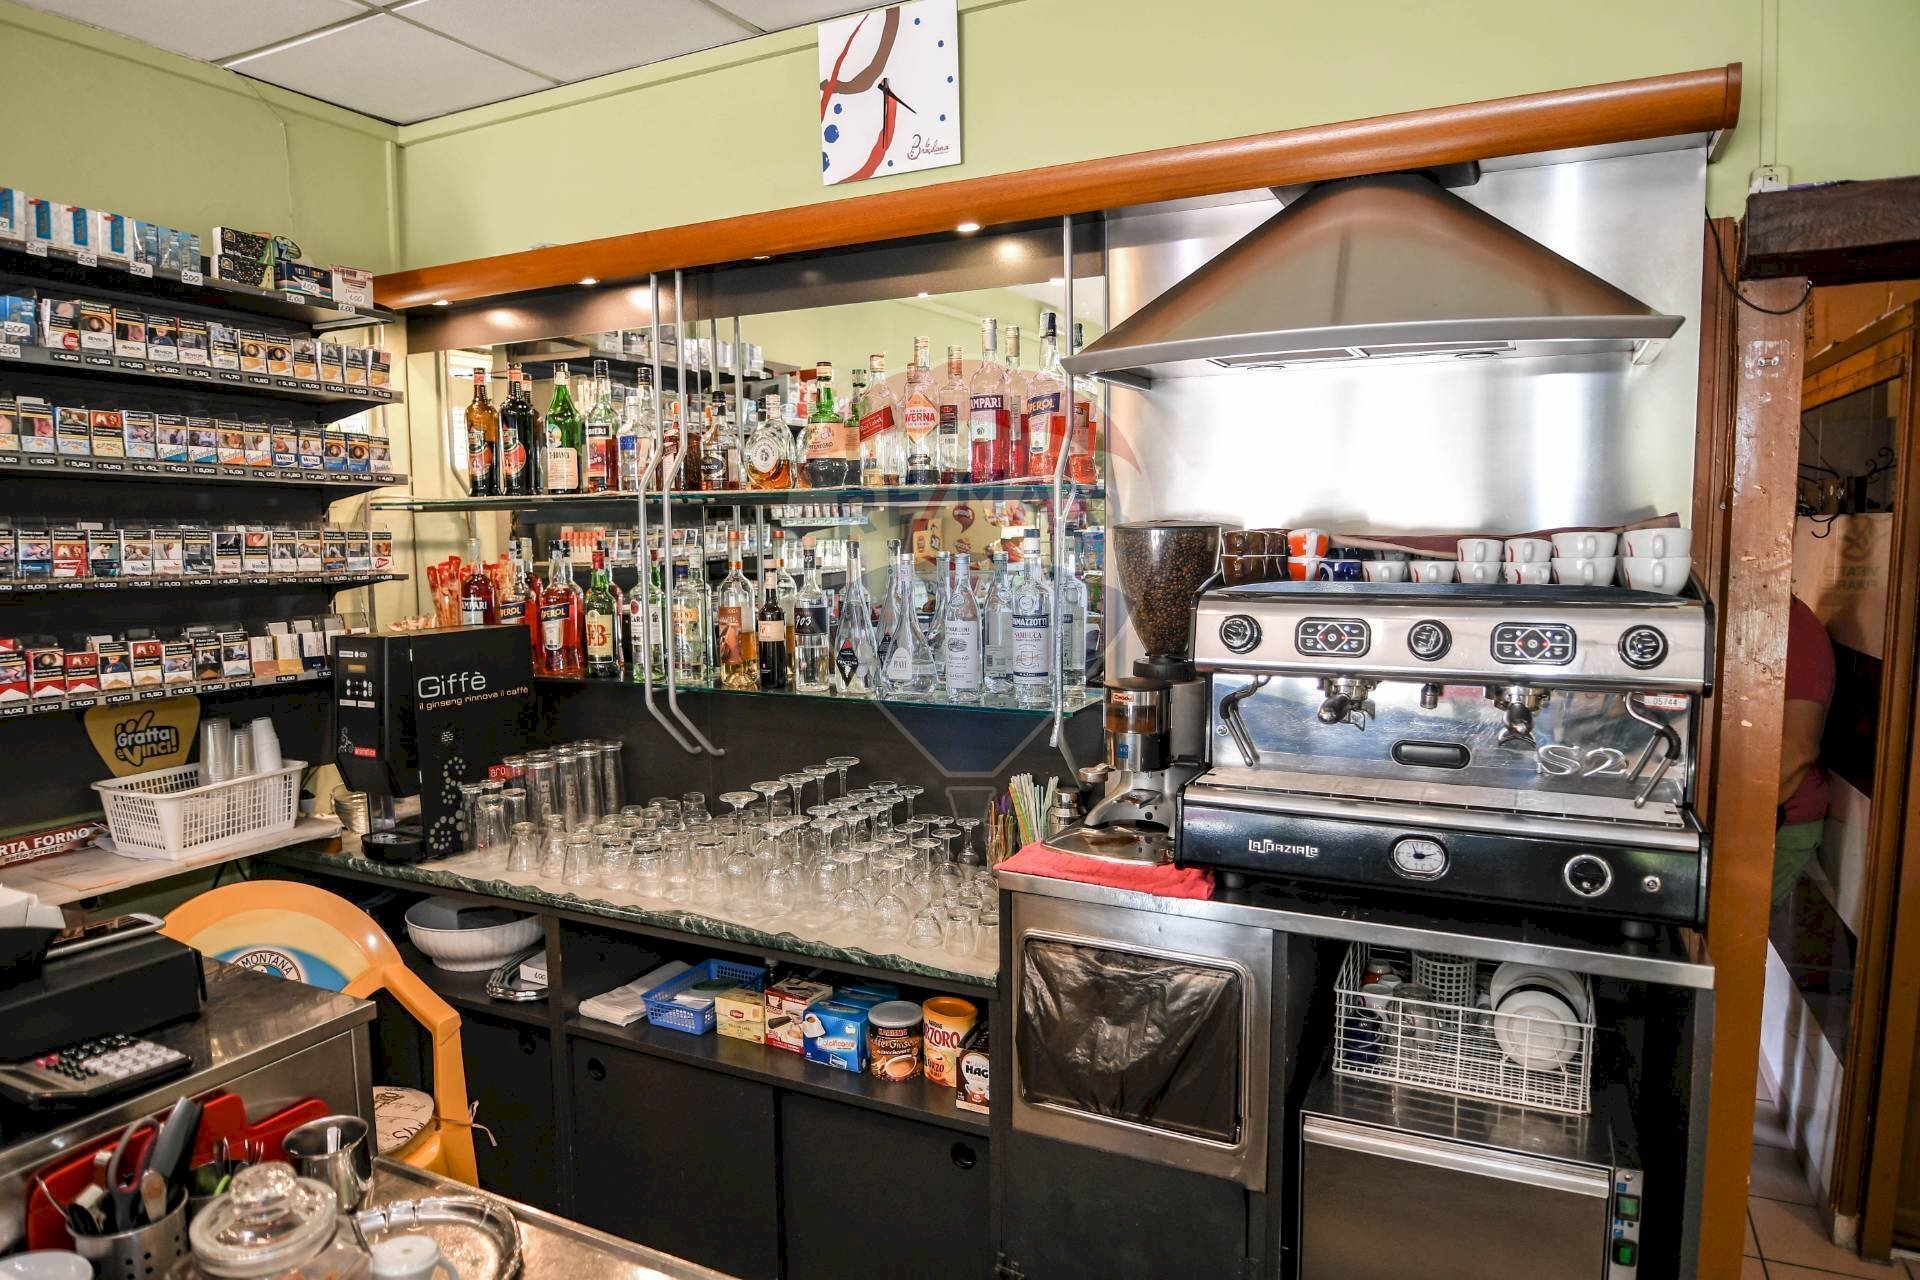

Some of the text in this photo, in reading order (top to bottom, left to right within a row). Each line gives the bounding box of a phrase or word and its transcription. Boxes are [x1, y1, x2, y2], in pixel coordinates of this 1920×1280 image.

[970, 397, 1001, 409] AMPARI
[462, 601, 487, 611] AMPARI
[417, 671, 487, 699] Giffè
[426, 697, 463, 711] ginseng
[465, 690, 499, 704] rinnova
[117, 728, 170, 747] Gratta
[0, 828, 91, 857] RTA FORNO
[240, 953, 293, 976] MONTANA
[965, 1064, 989, 1079] HAG
